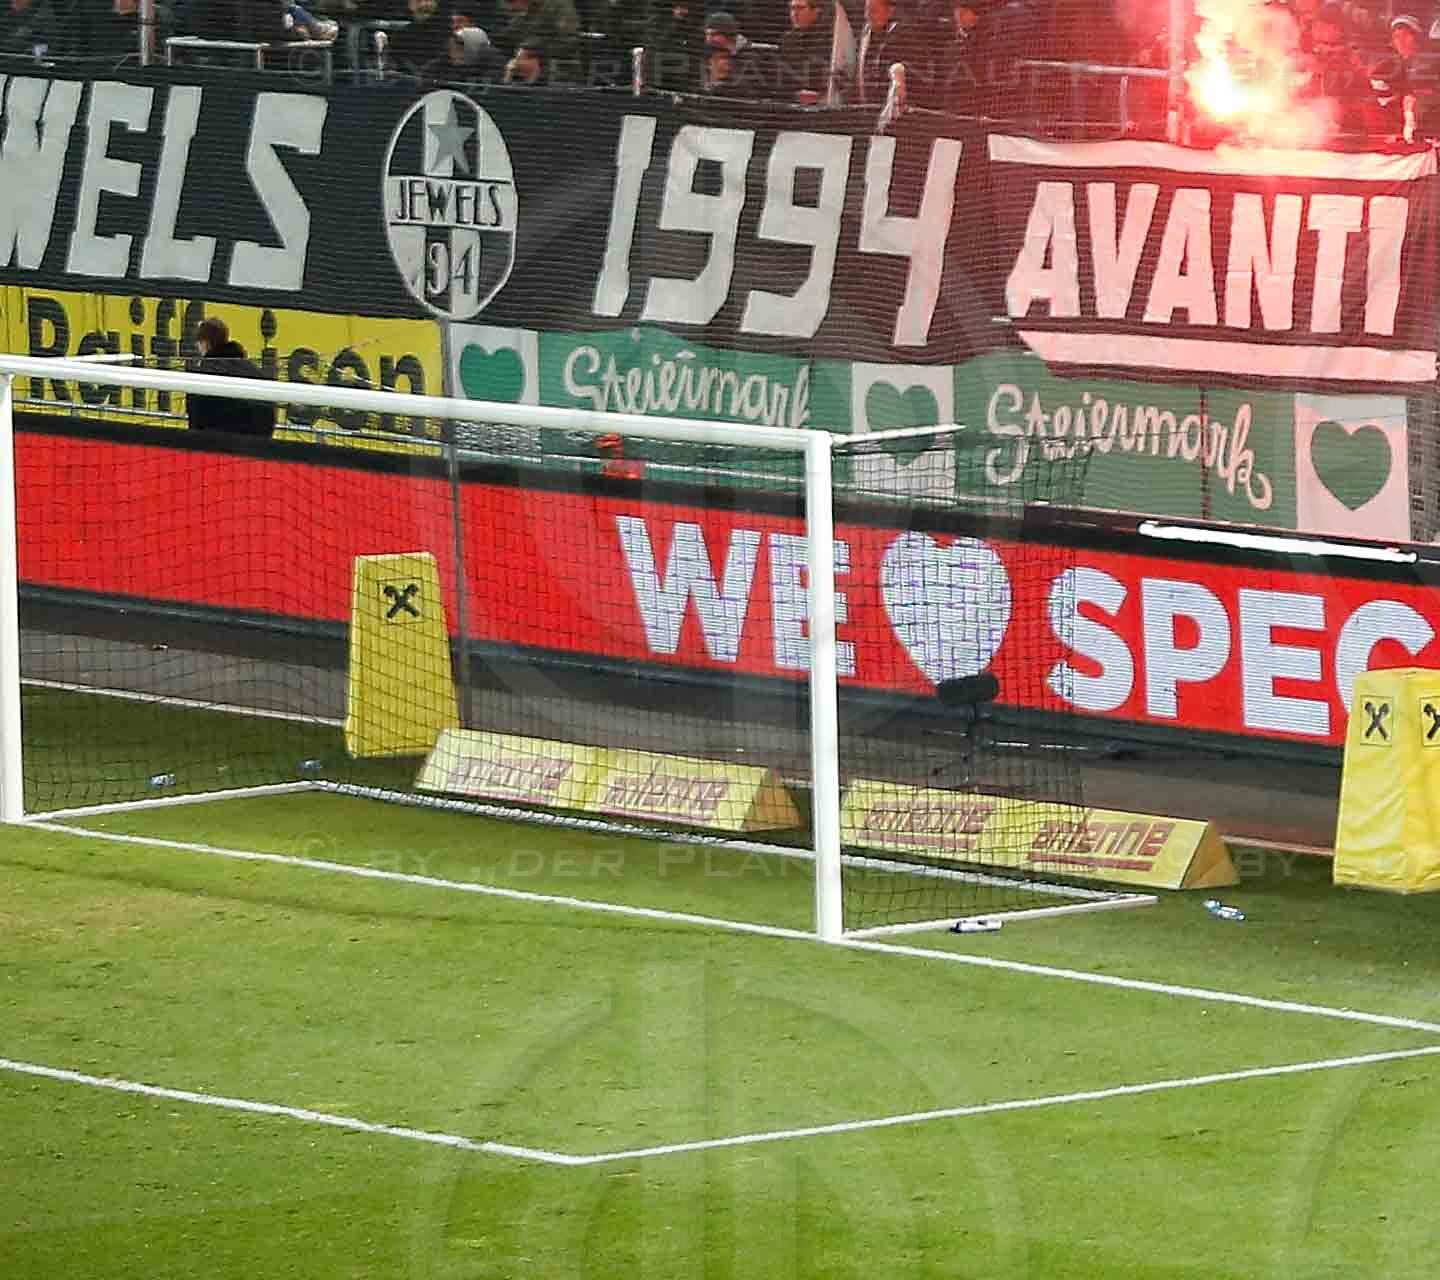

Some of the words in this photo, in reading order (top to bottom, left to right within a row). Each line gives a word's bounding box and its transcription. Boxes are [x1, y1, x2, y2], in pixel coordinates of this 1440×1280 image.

[395, 178, 502, 228] JEWELS
[424, 240, 477, 300] 94
[592, 114, 964, 348] 1994
[1005, 182, 1409, 337] AVANTI
[986, 382, 1274, 512] Steiermark
[615, 513, 857, 677] WE
